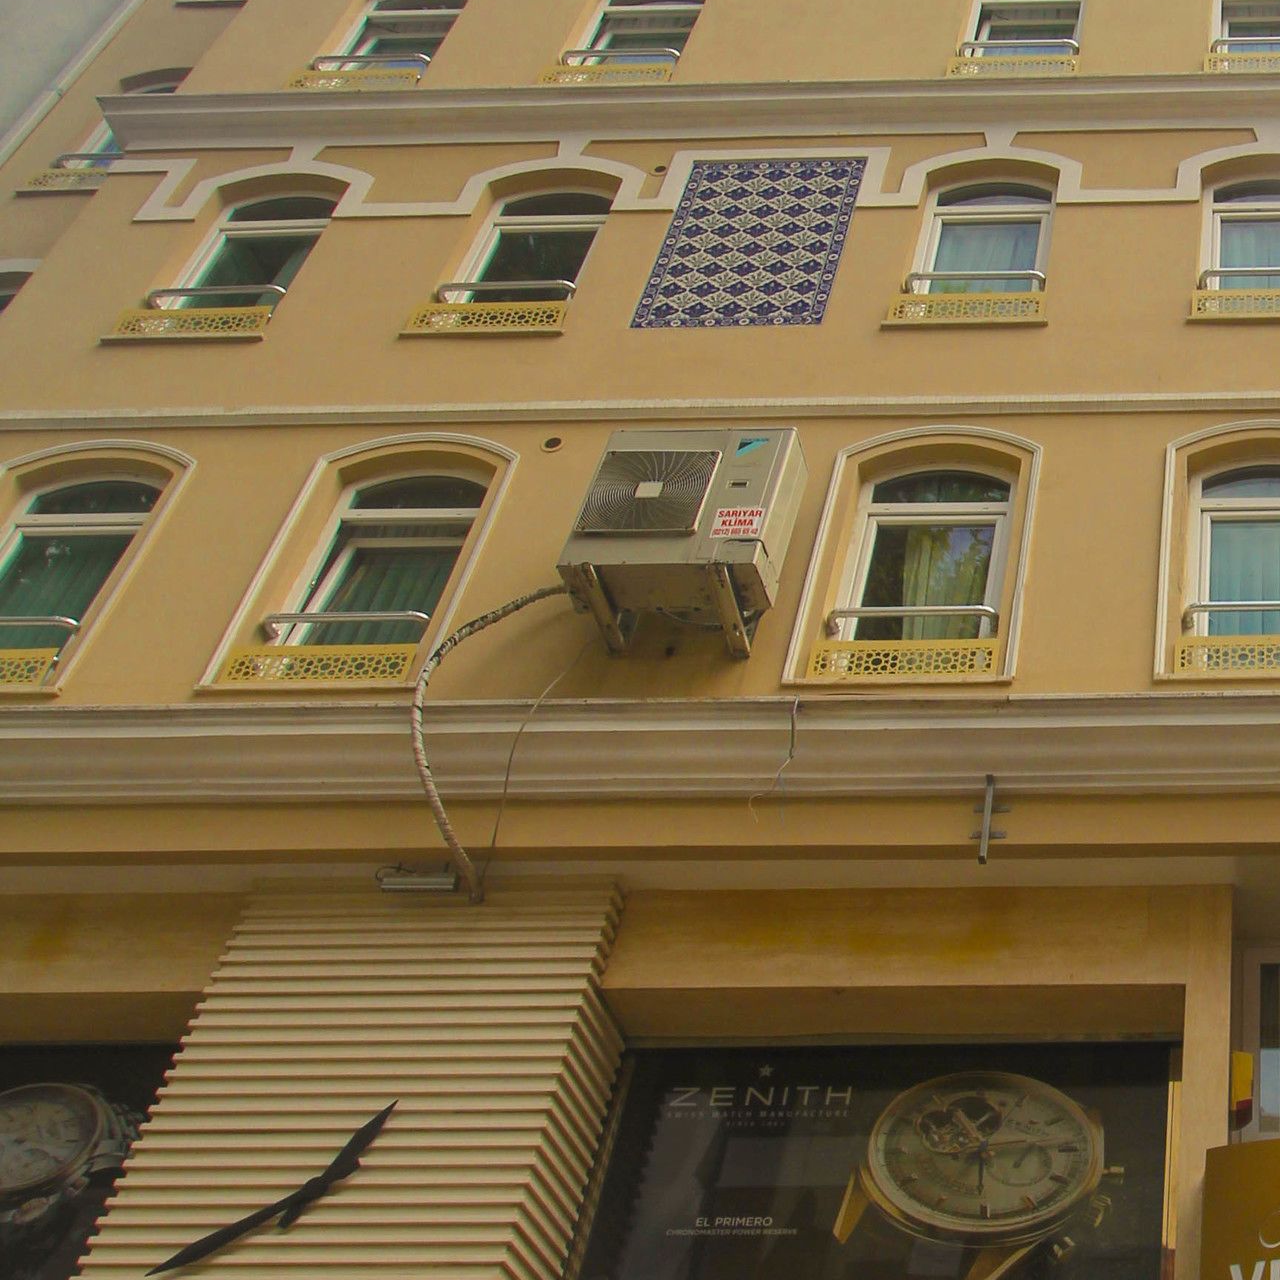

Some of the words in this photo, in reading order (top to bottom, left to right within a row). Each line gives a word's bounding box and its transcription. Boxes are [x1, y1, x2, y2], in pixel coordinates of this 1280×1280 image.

[721, 517, 754, 527] KLİMA
[669, 1086, 853, 1107] ZENITH
[695, 1217, 711, 1228] EL
[714, 1216, 773, 1227] PRIMERO
